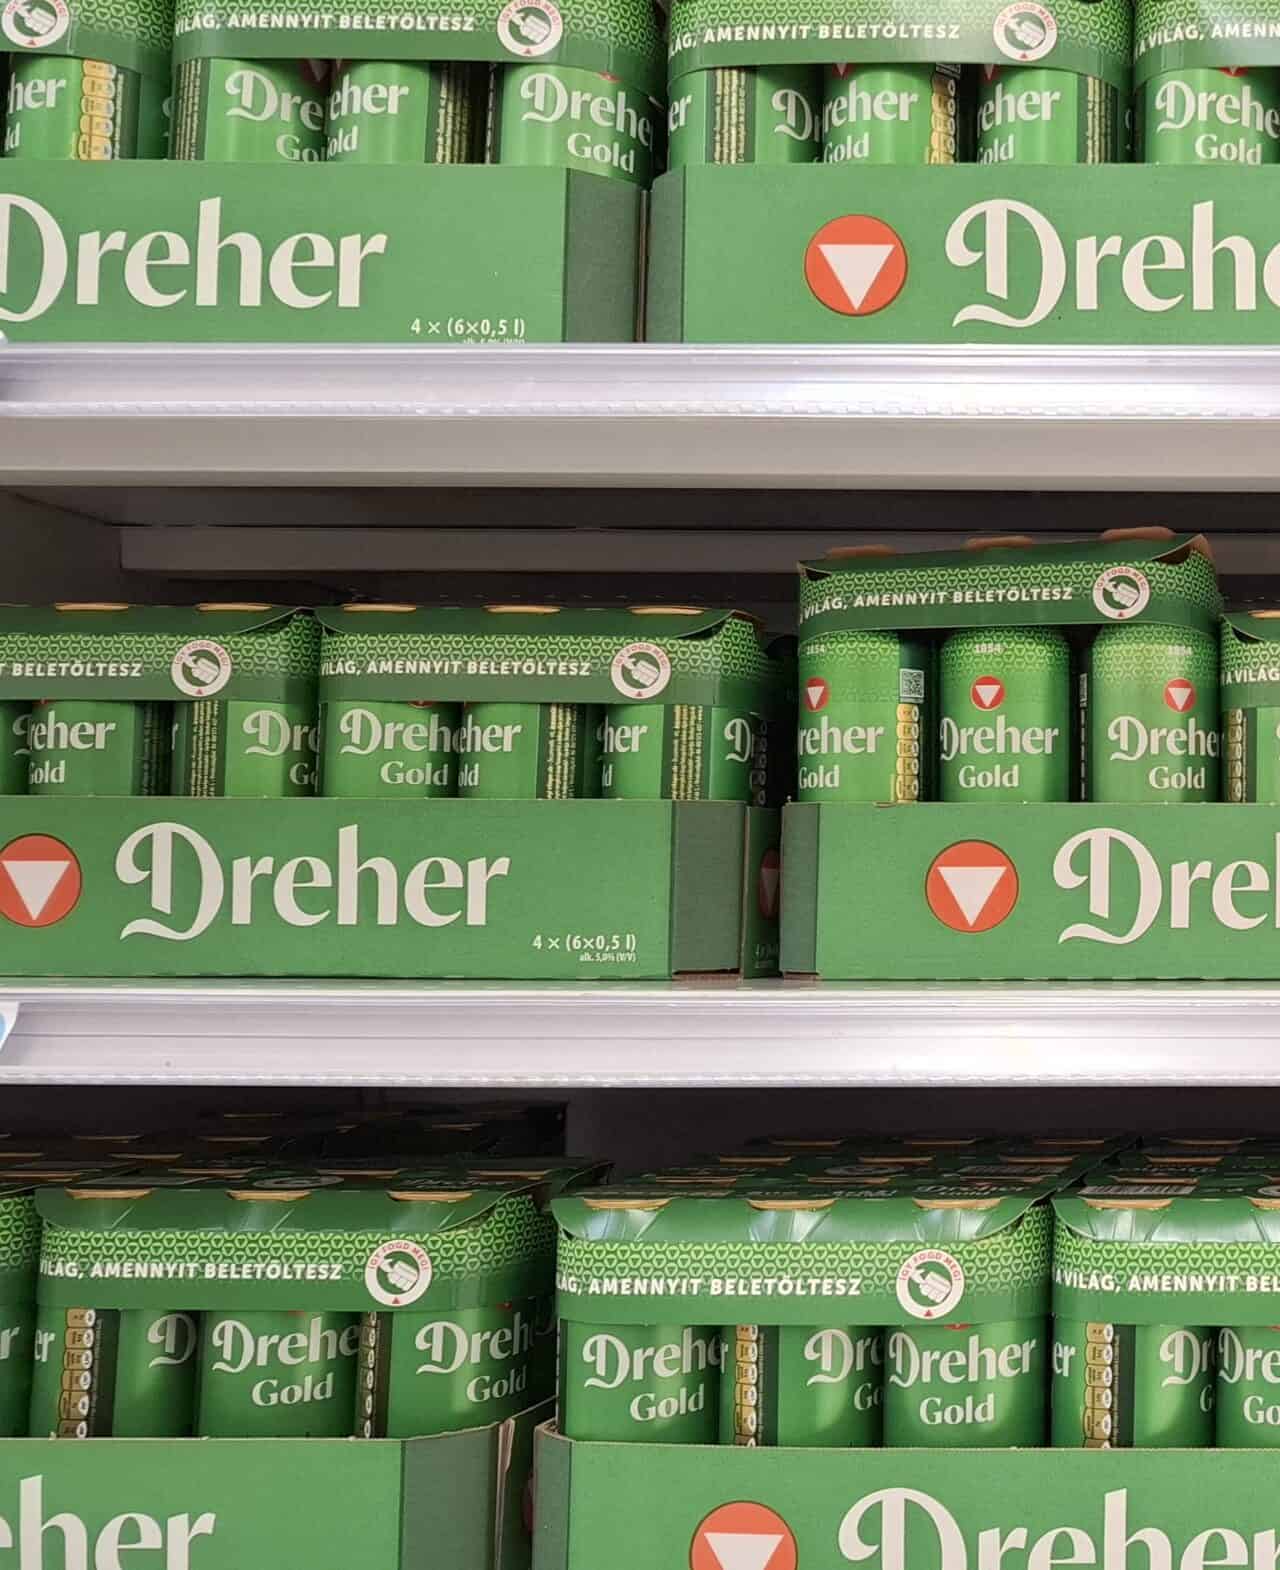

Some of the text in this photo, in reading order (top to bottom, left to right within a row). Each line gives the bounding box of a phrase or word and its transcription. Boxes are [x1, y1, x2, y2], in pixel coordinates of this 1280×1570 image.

[228, 12, 331, 29] AMENNYIT
[339, 13, 475, 31] BELETÖLTESZ
[704, 20, 960, 43] AMENNYIT BELETÖLTESZ
[1149, 23, 1203, 46] VILÁG,
[567, 132, 635, 174] Gold
[1195, 134, 1262, 165] Gold
[410, 318, 421, 335] 4
[804, 587, 1072, 620] VILÁG, AMENNYIT BELETÖLTESZ
[12, 660, 143, 677] BELETÖLTESZ
[367, 660, 462, 676] AMENNYIT
[467, 658, 591, 677] BELETÖLTESZ
[1108, 715, 1219, 761] Drehe
[380, 760, 448, 786] Gold
[959, 764, 1019, 790] Gold
[1149, 765, 1206, 790] Gold
[114, 822, 511, 940] Dreher
[532, 934, 542, 949] 4
[90, 1262, 196, 1279] AMENNYIT
[204, 1260, 342, 1280] BELETÖLTESZ
[1063, 1271, 1121, 1293] VILÁG,
[1128, 1275, 1239, 1292] AMENNYIT
[589, 1276, 861, 1296] AMENNYIT BELETÖLTESZ
[212, 1317, 360, 1373] Drehe
[889, 1332, 1036, 1387] Dreher
[252, 1372, 333, 1407] Gold
[466, 1364, 527, 1403] Gold
[630, 1384, 704, 1421] Gold
[919, 1393, 995, 1425] Gold
